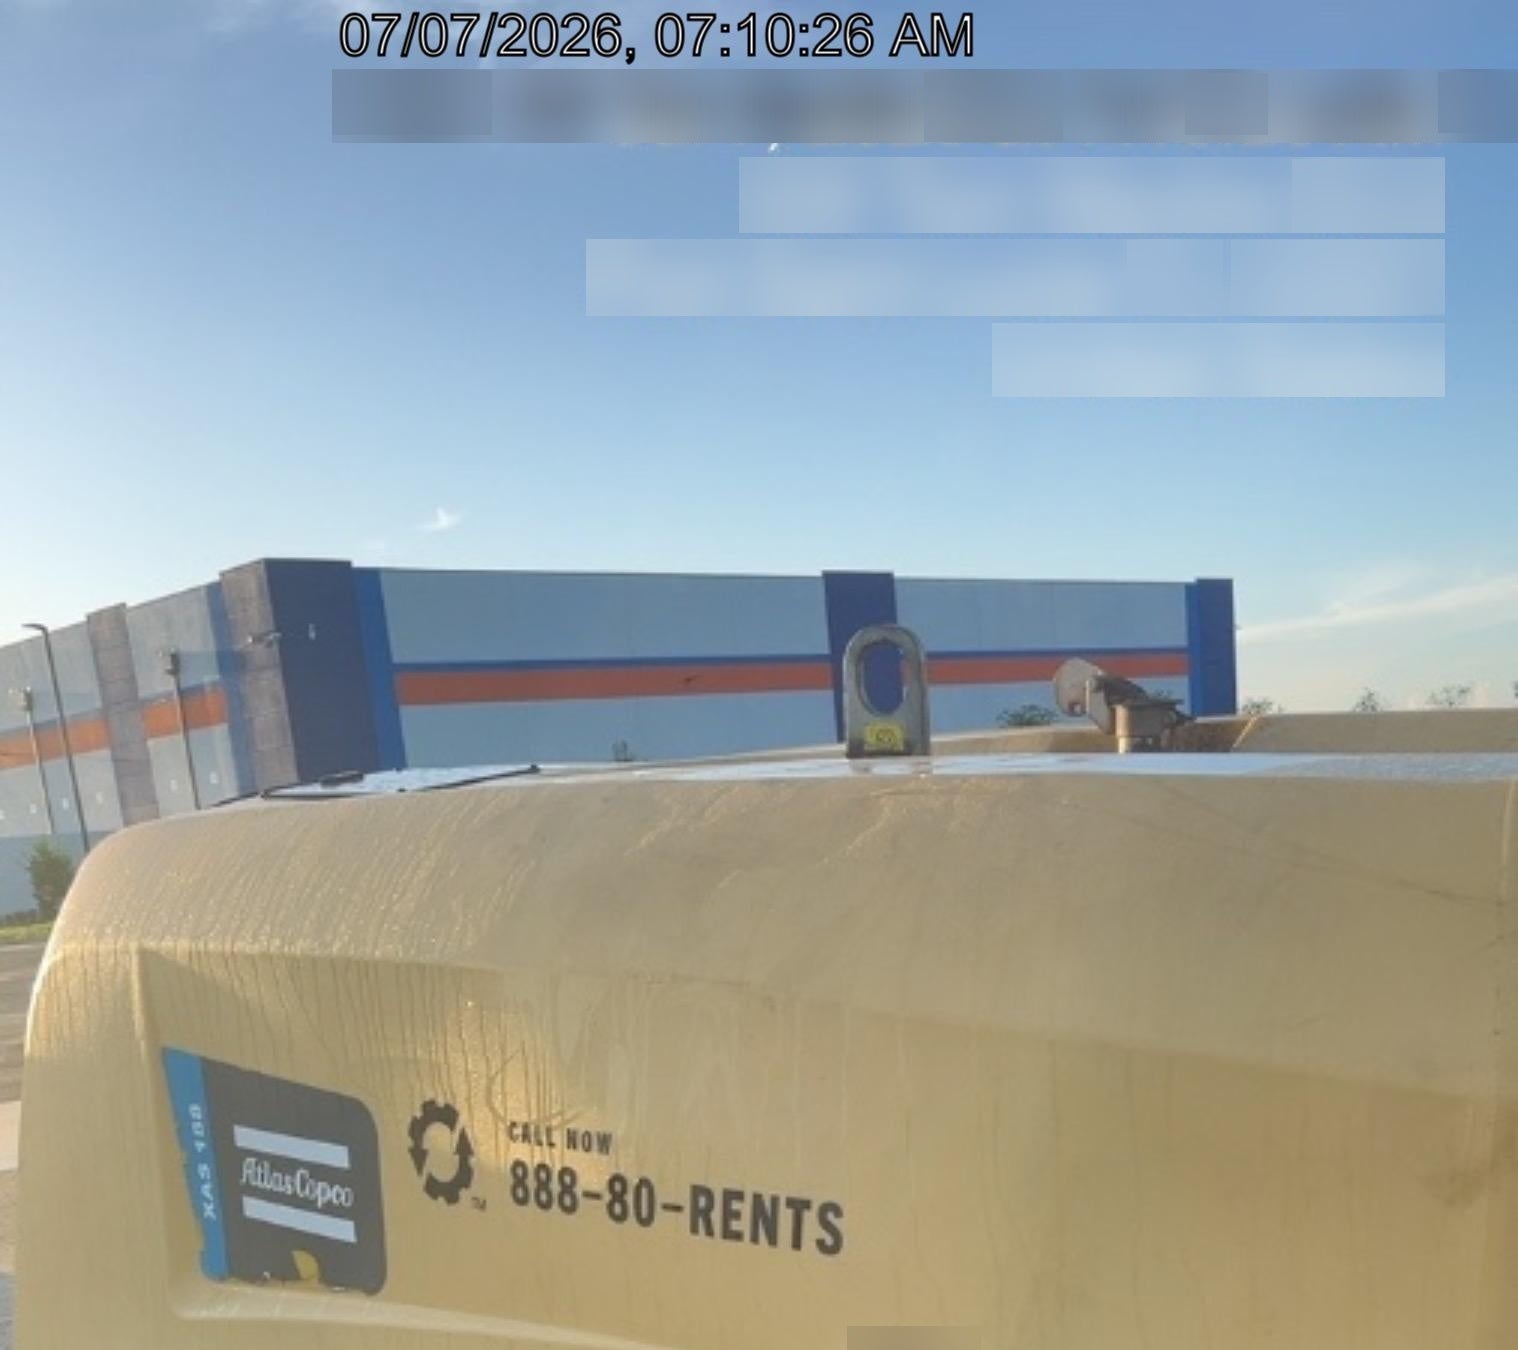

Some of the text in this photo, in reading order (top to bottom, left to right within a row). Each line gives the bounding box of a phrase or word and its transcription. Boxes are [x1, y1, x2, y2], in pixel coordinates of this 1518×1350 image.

[507, 1120, 613, 1156] CALL NOW
[508, 1158, 845, 1256] 888-80-RENTS
